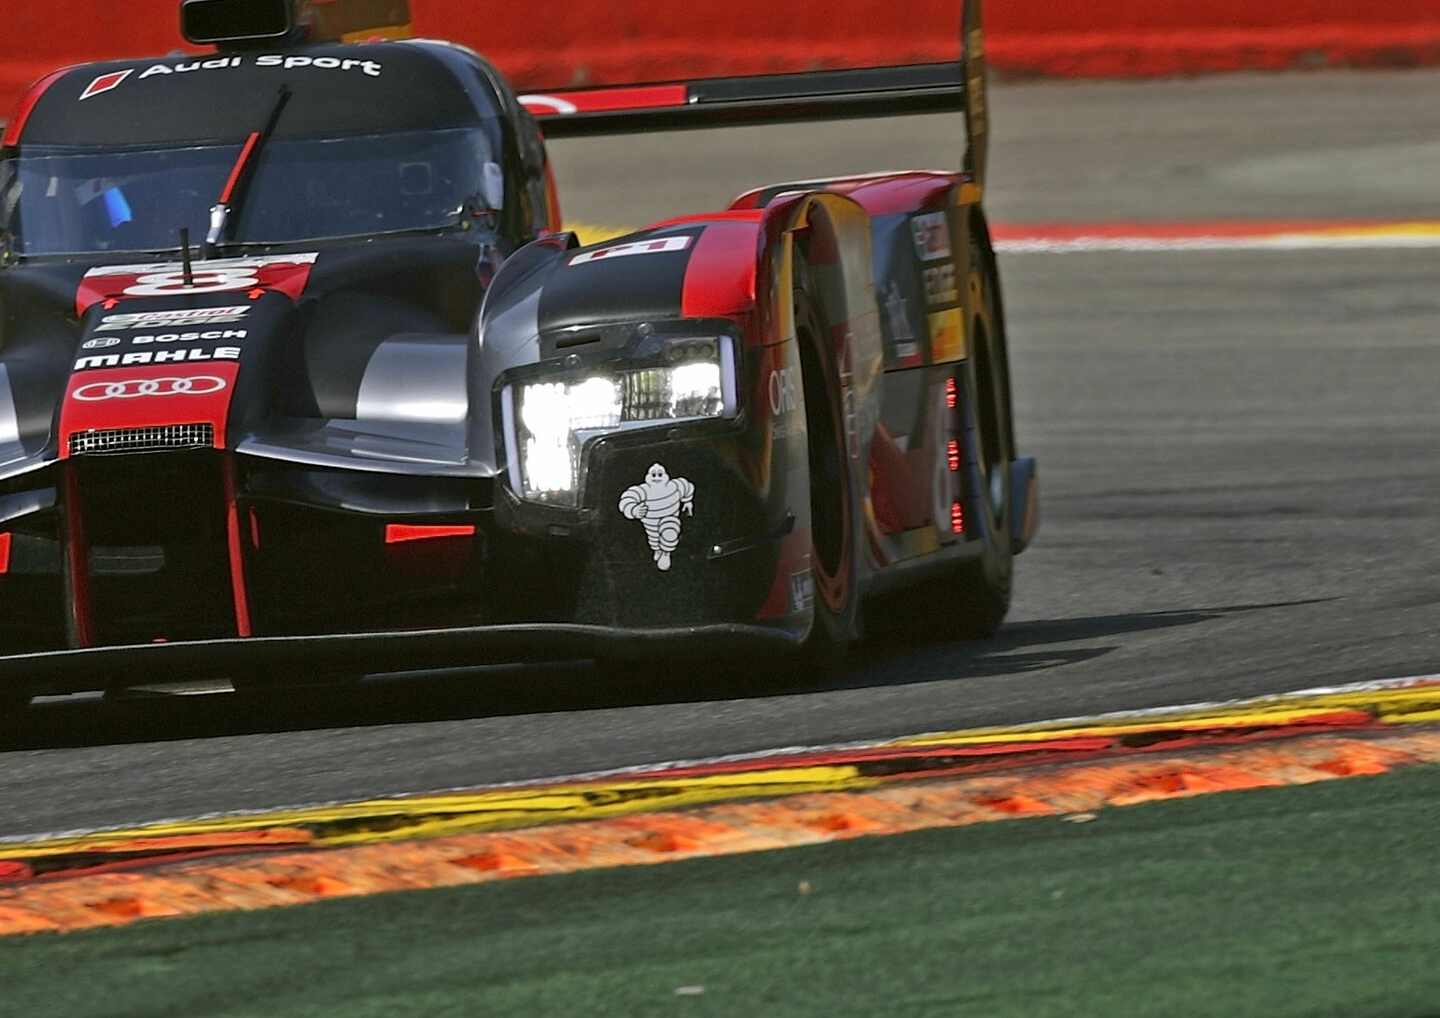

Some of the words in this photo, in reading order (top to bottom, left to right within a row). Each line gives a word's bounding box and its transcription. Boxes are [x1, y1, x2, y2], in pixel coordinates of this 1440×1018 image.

[138, 56, 241, 79] Audi
[255, 55, 381, 77] Sport
[93, 313, 250, 333] EDGE
[137, 307, 238, 322] Castrol
[132, 329, 248, 345] BOSCH
[73, 346, 242, 371] MAHLE
